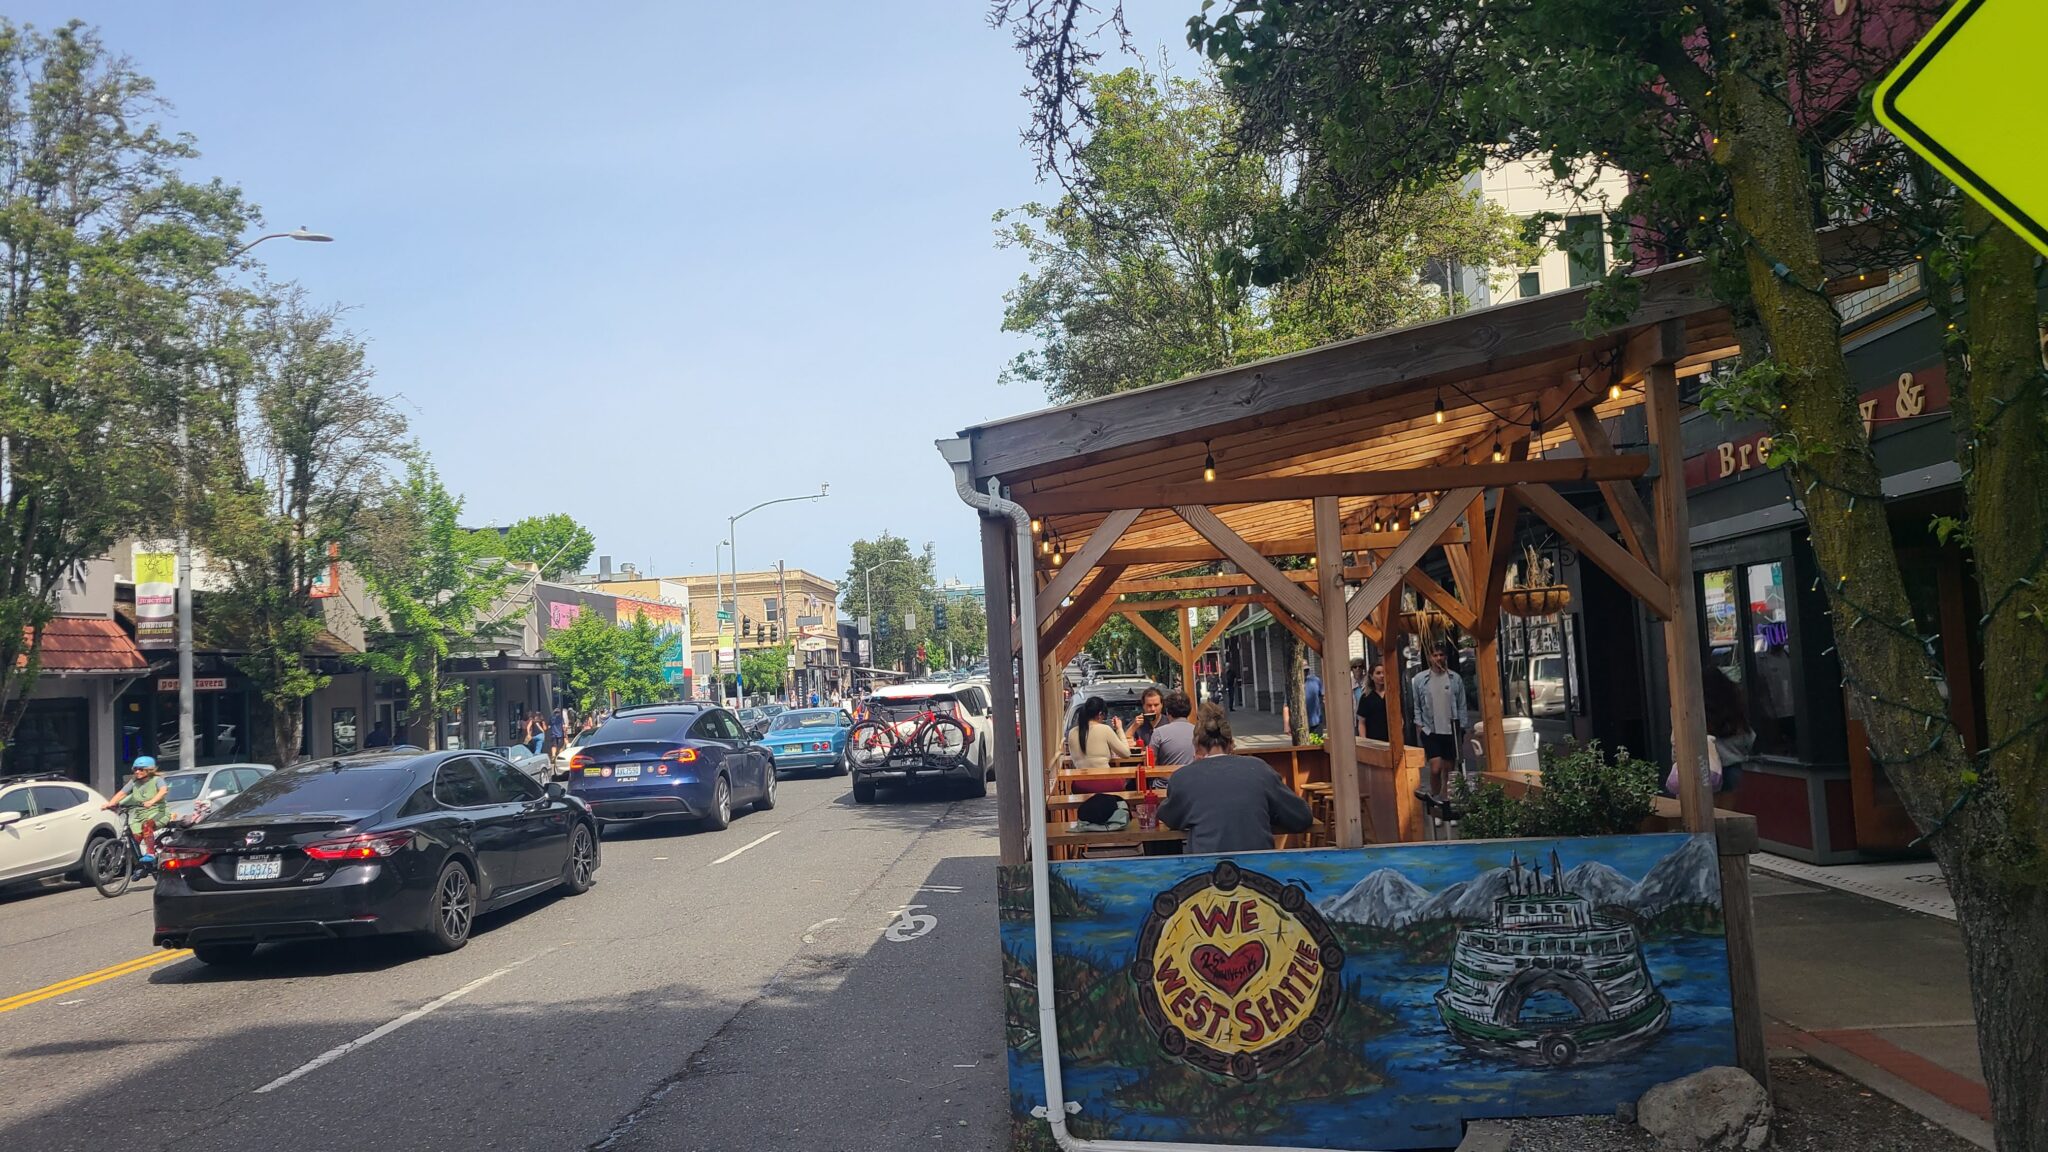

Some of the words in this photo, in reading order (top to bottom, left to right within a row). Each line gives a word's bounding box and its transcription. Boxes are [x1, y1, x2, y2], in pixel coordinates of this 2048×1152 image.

[1895, 372, 1926, 418] &
[195, 680, 224, 688] tavern
[238, 863, 279, 876] CLG9763
[1191, 899, 1260, 938] WE
[1156, 954, 1230, 1040] WEST
[1235, 939, 1320, 1042] SEATTLE
